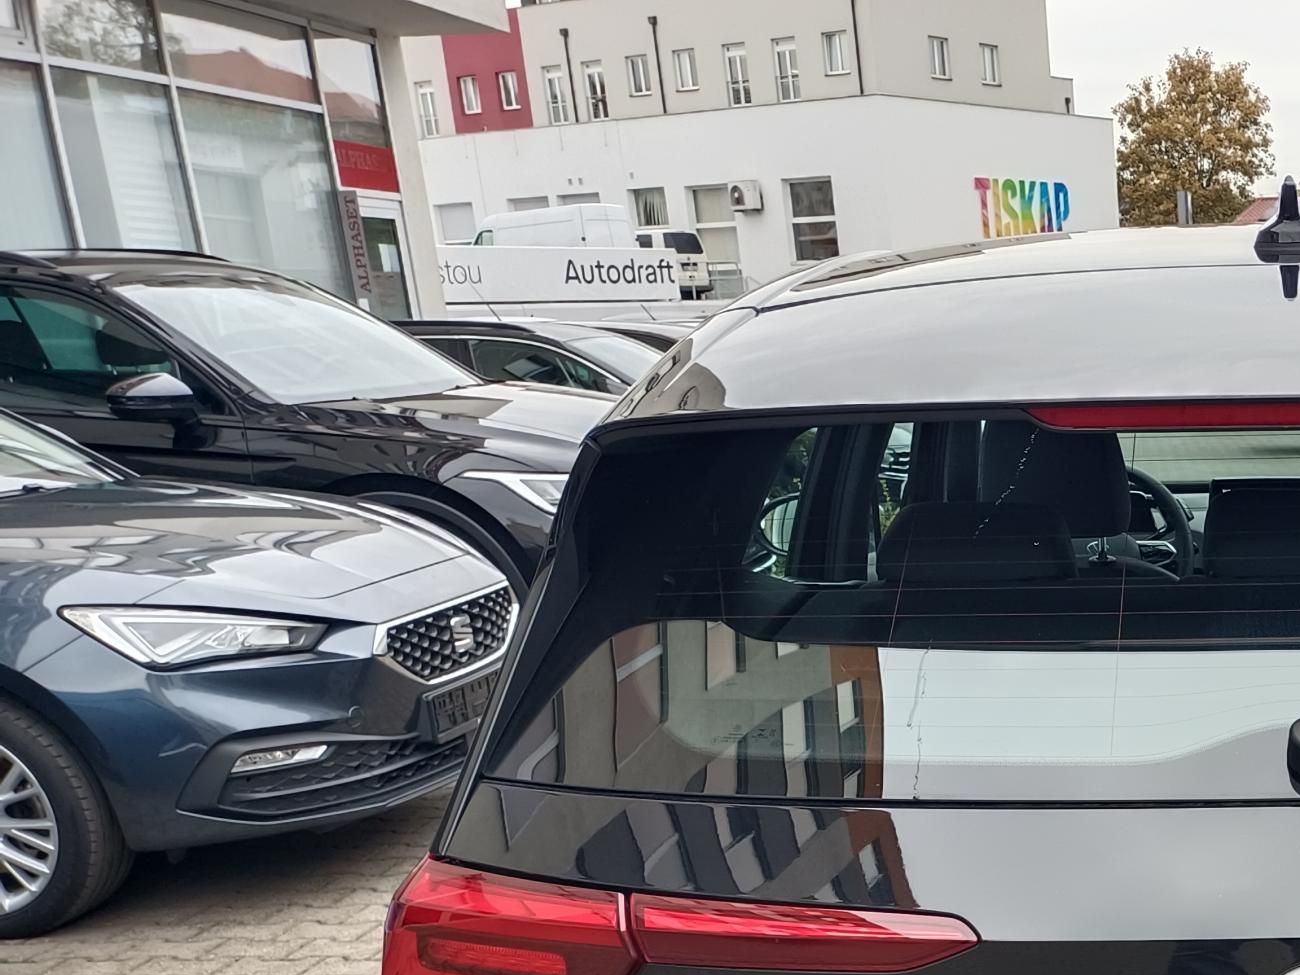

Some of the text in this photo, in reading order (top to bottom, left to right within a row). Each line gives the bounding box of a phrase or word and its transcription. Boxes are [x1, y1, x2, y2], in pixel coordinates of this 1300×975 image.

[973, 177, 1070, 239] TISKAP
[343, 195, 372, 294] ALPHASET
[564, 258, 676, 285] Autodraft
